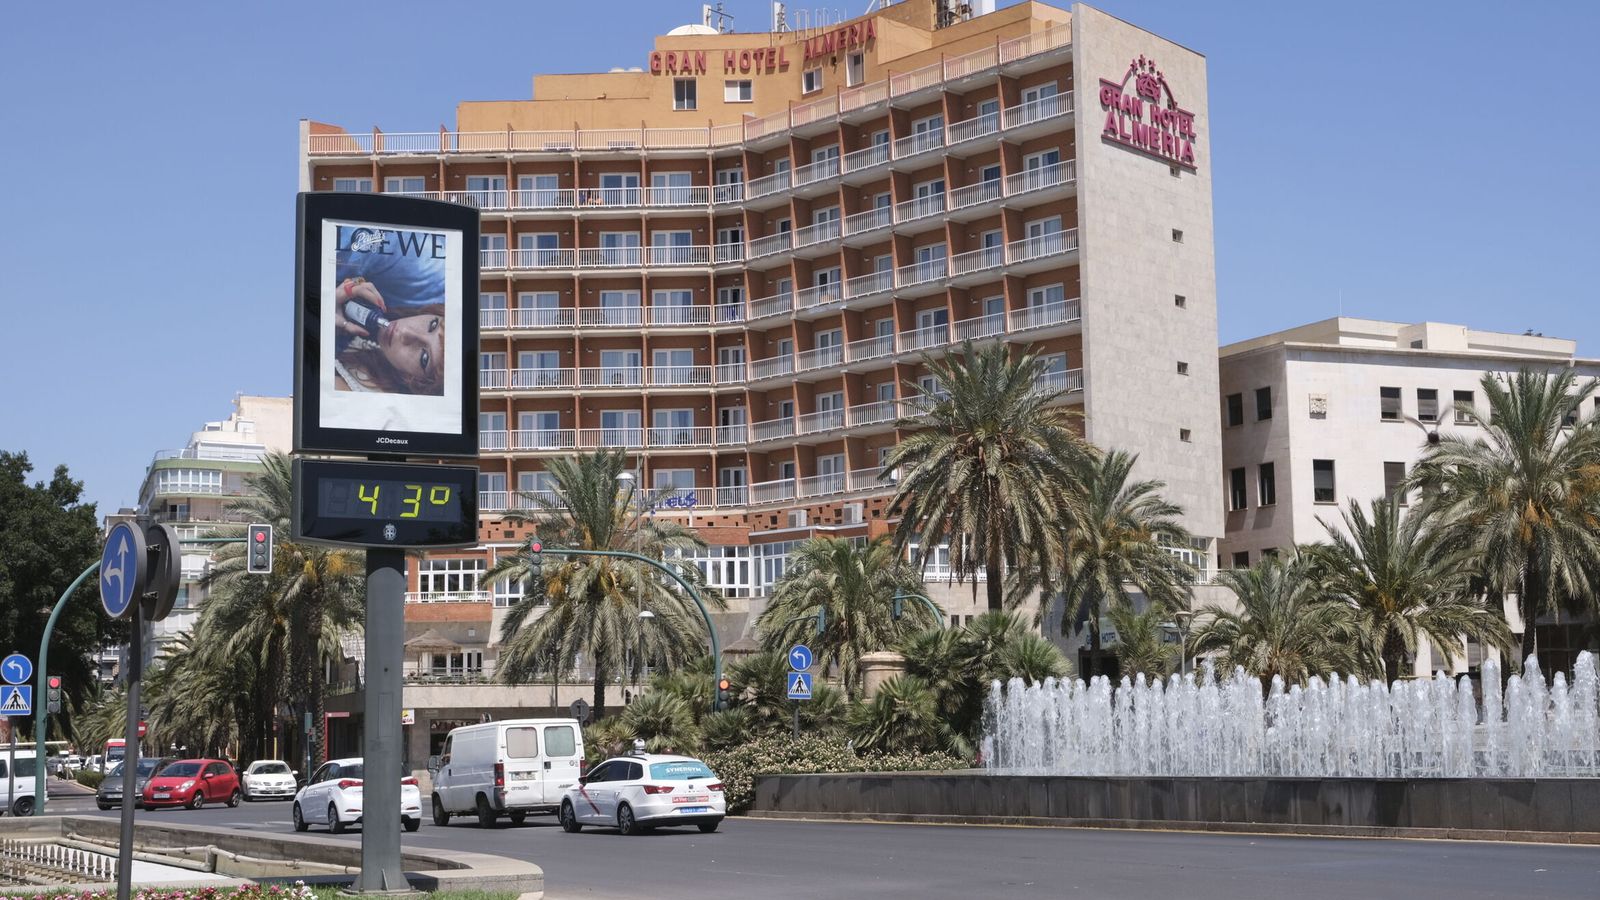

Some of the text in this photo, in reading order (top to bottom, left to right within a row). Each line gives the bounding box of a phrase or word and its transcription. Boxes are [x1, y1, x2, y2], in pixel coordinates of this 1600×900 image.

[650, 19, 877, 73] GRAN HOTEL ALMERIA
[1099, 85, 1197, 139] GRAN HOTEL
[1103, 111, 1195, 163] ALMERIA
[335, 225, 446, 259] LOEWE
[375, 437, 409, 445] JCDecaux
